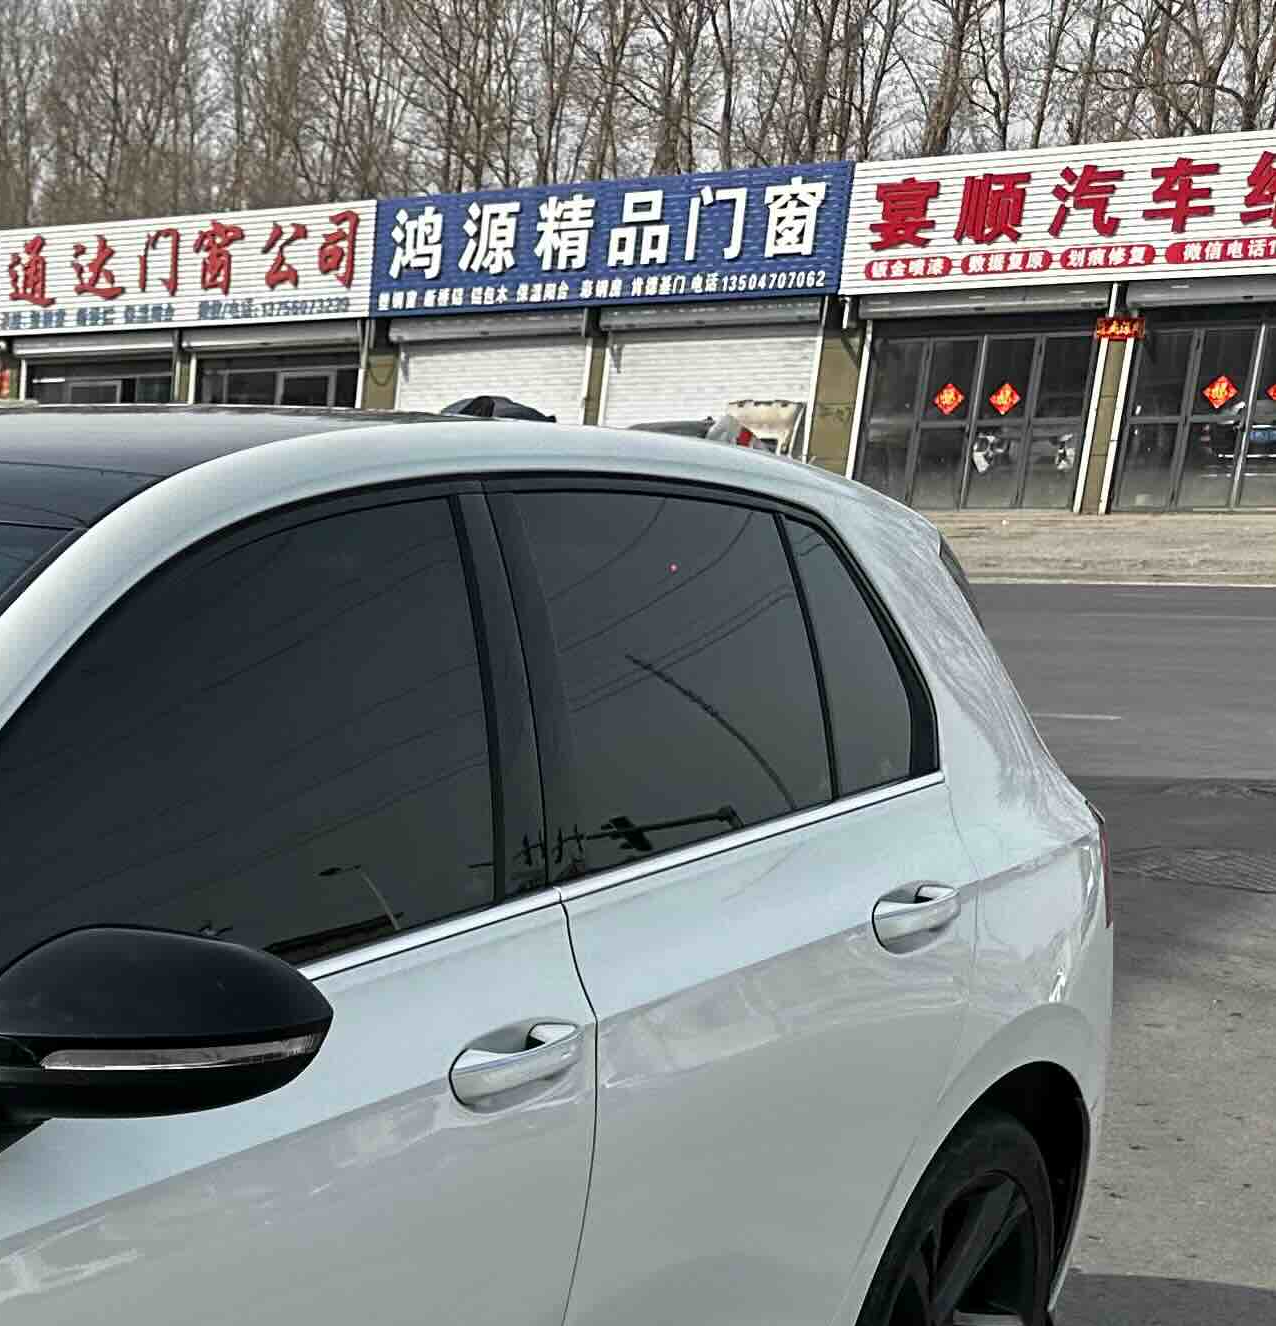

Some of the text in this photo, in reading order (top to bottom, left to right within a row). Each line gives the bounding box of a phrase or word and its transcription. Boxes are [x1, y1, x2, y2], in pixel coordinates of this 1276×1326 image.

[8, 210, 360, 307] 通达门窗公司
[389, 177, 828, 280] 鸿源精品门窗
